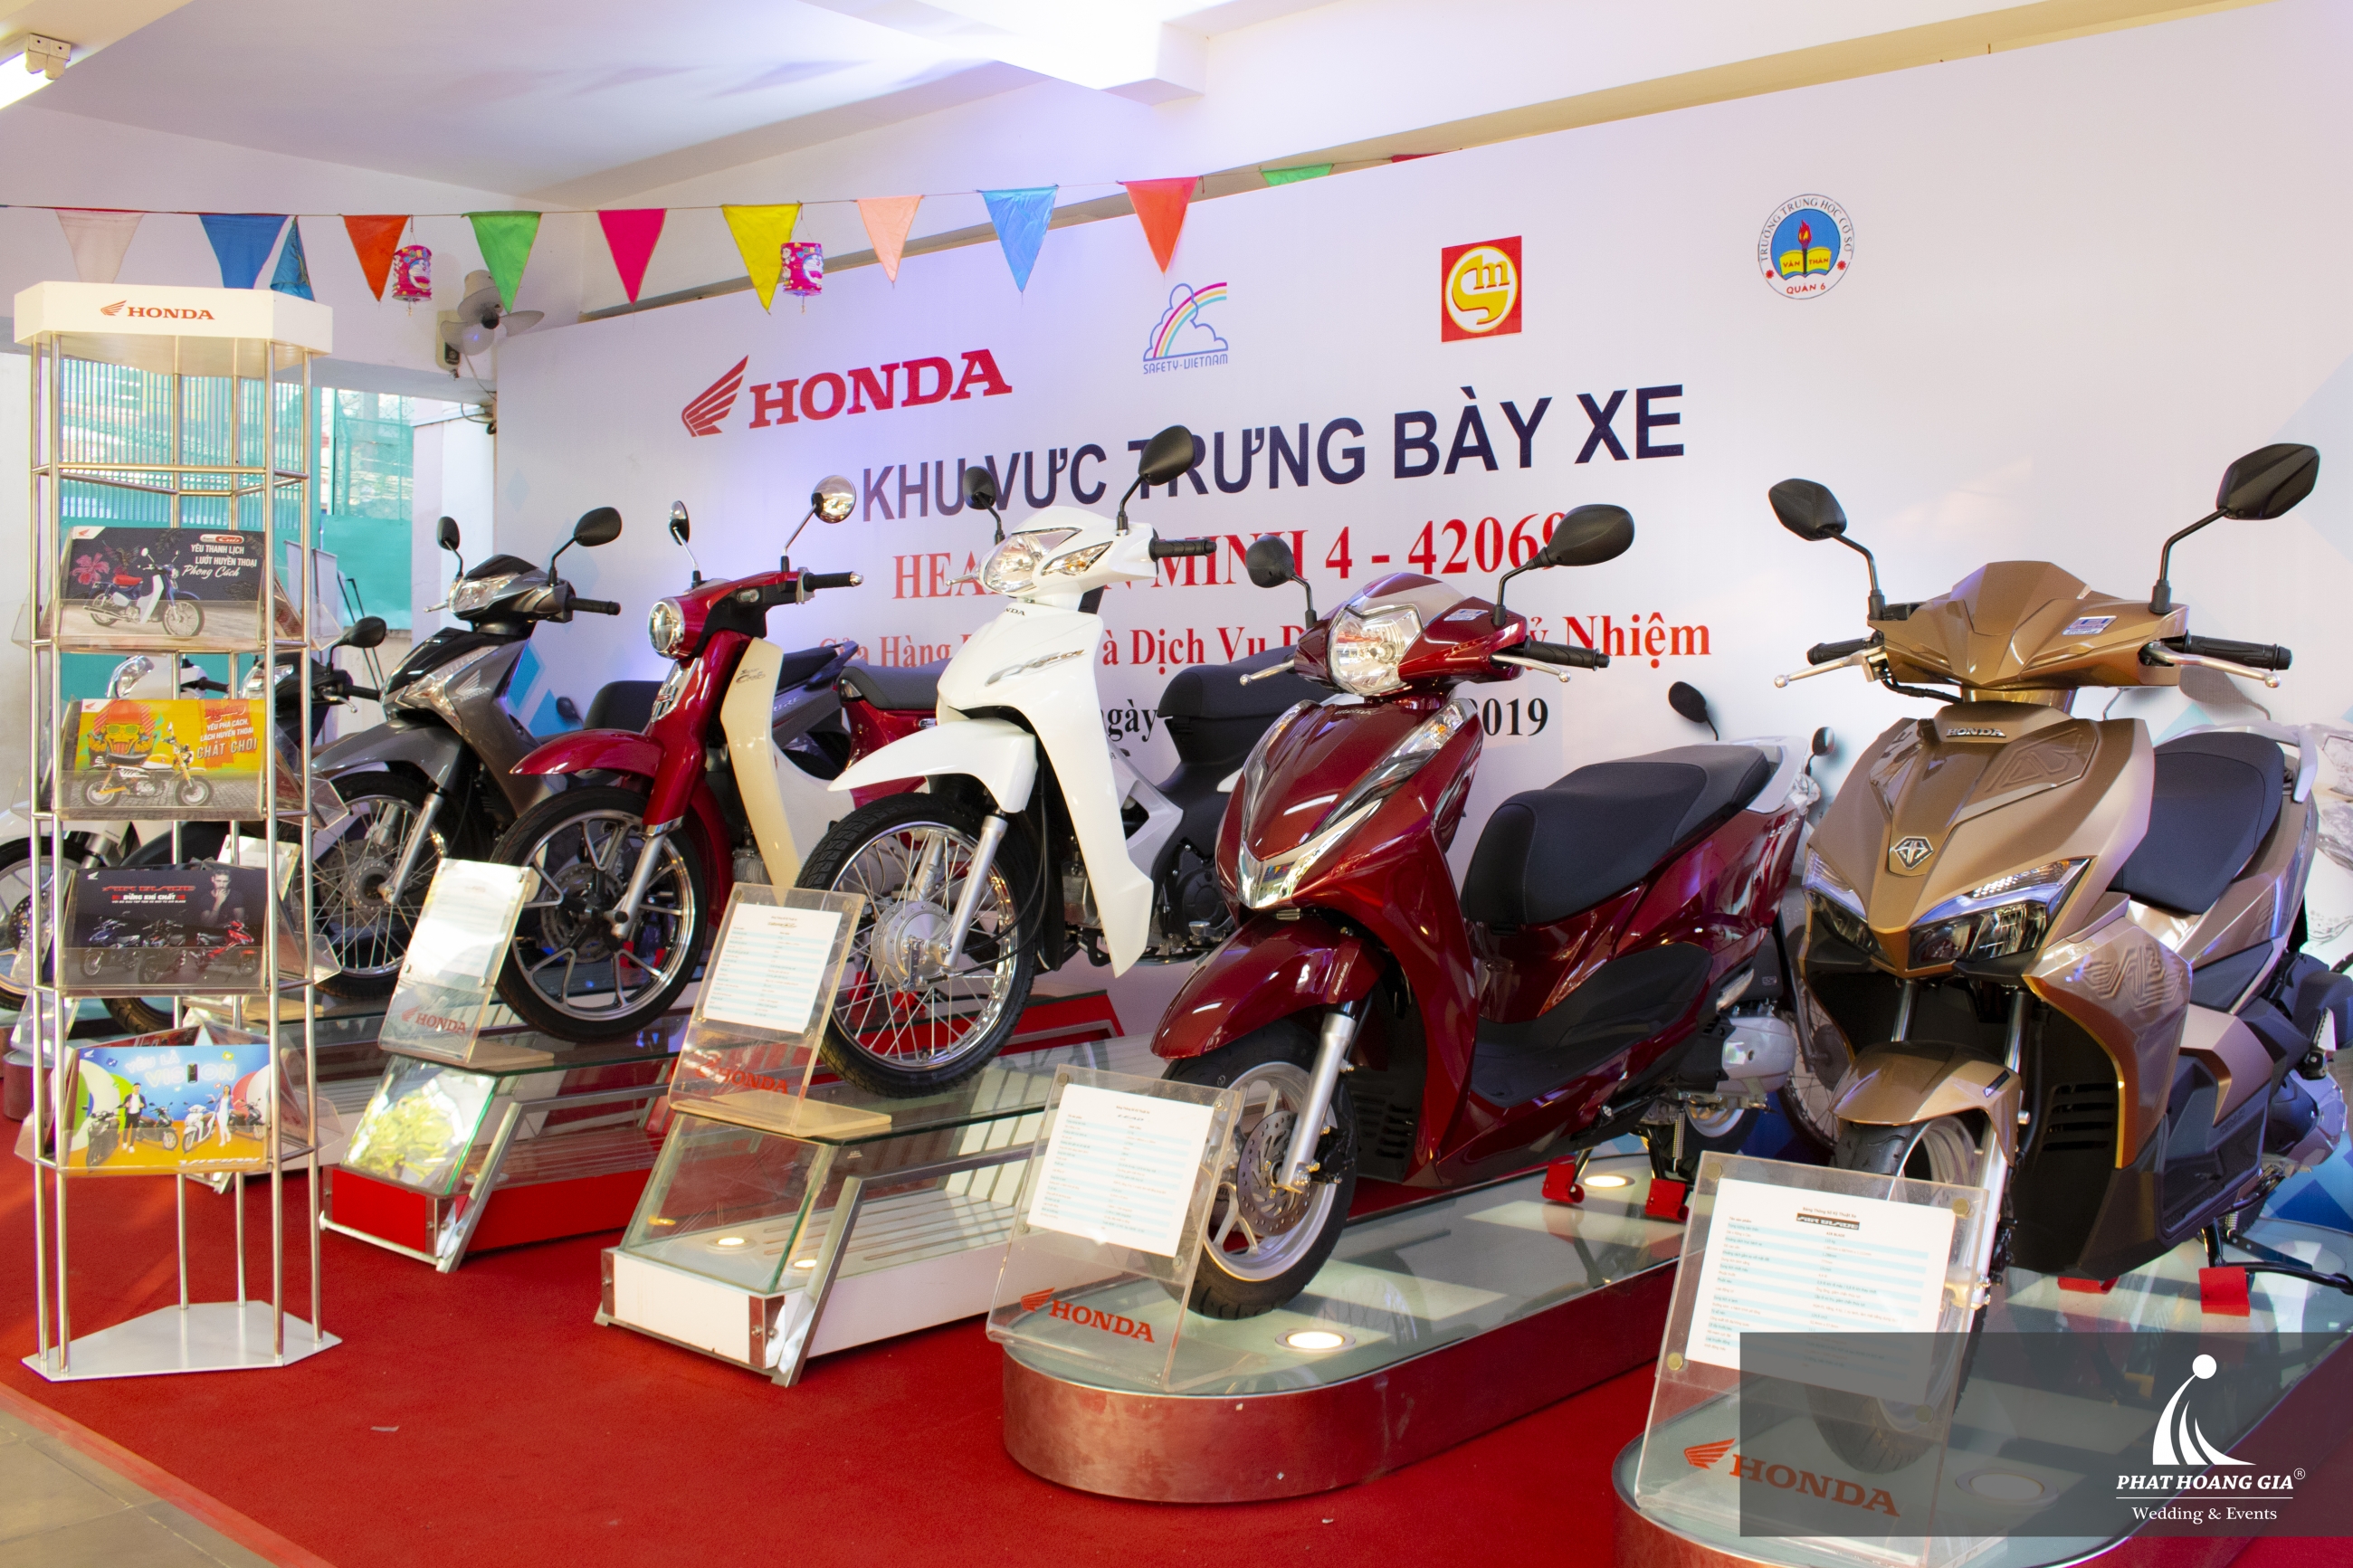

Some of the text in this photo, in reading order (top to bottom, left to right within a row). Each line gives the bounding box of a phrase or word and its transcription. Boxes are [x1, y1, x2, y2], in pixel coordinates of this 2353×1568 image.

[1820, 282, 1826, 290] 6
[128, 307, 215, 320] HONDA
[748, 348, 1013, 429] HONDA
[862, 457, 966, 522] KHU
[1395, 385, 1553, 480] BÀY
[1575, 384, 1684, 465] XE
[205, 545, 228, 554] THANH
[181, 564, 214, 580] Phong
[891, 550, 1003, 600] HEA
[1325, 526, 1353, 580] 4
[1371, 554, 1390, 564] -
[1005, 607, 1026, 616] NDA
[1101, 629, 1119, 666] à
[1129, 627, 1206, 676] Dịch
[1562, 611, 1713, 670] Nhiệm
[460, 687, 491, 703] HONDA
[1101, 697, 1549, 743] gày 019
[1946, 727, 2007, 738] HONDA
[414, 1012, 467, 1034] HONDA
[718, 1068, 789, 1095] HONDA
[1048, 1299, 1156, 1344] HONDA
[1729, 1453, 1901, 1517] HONDA
